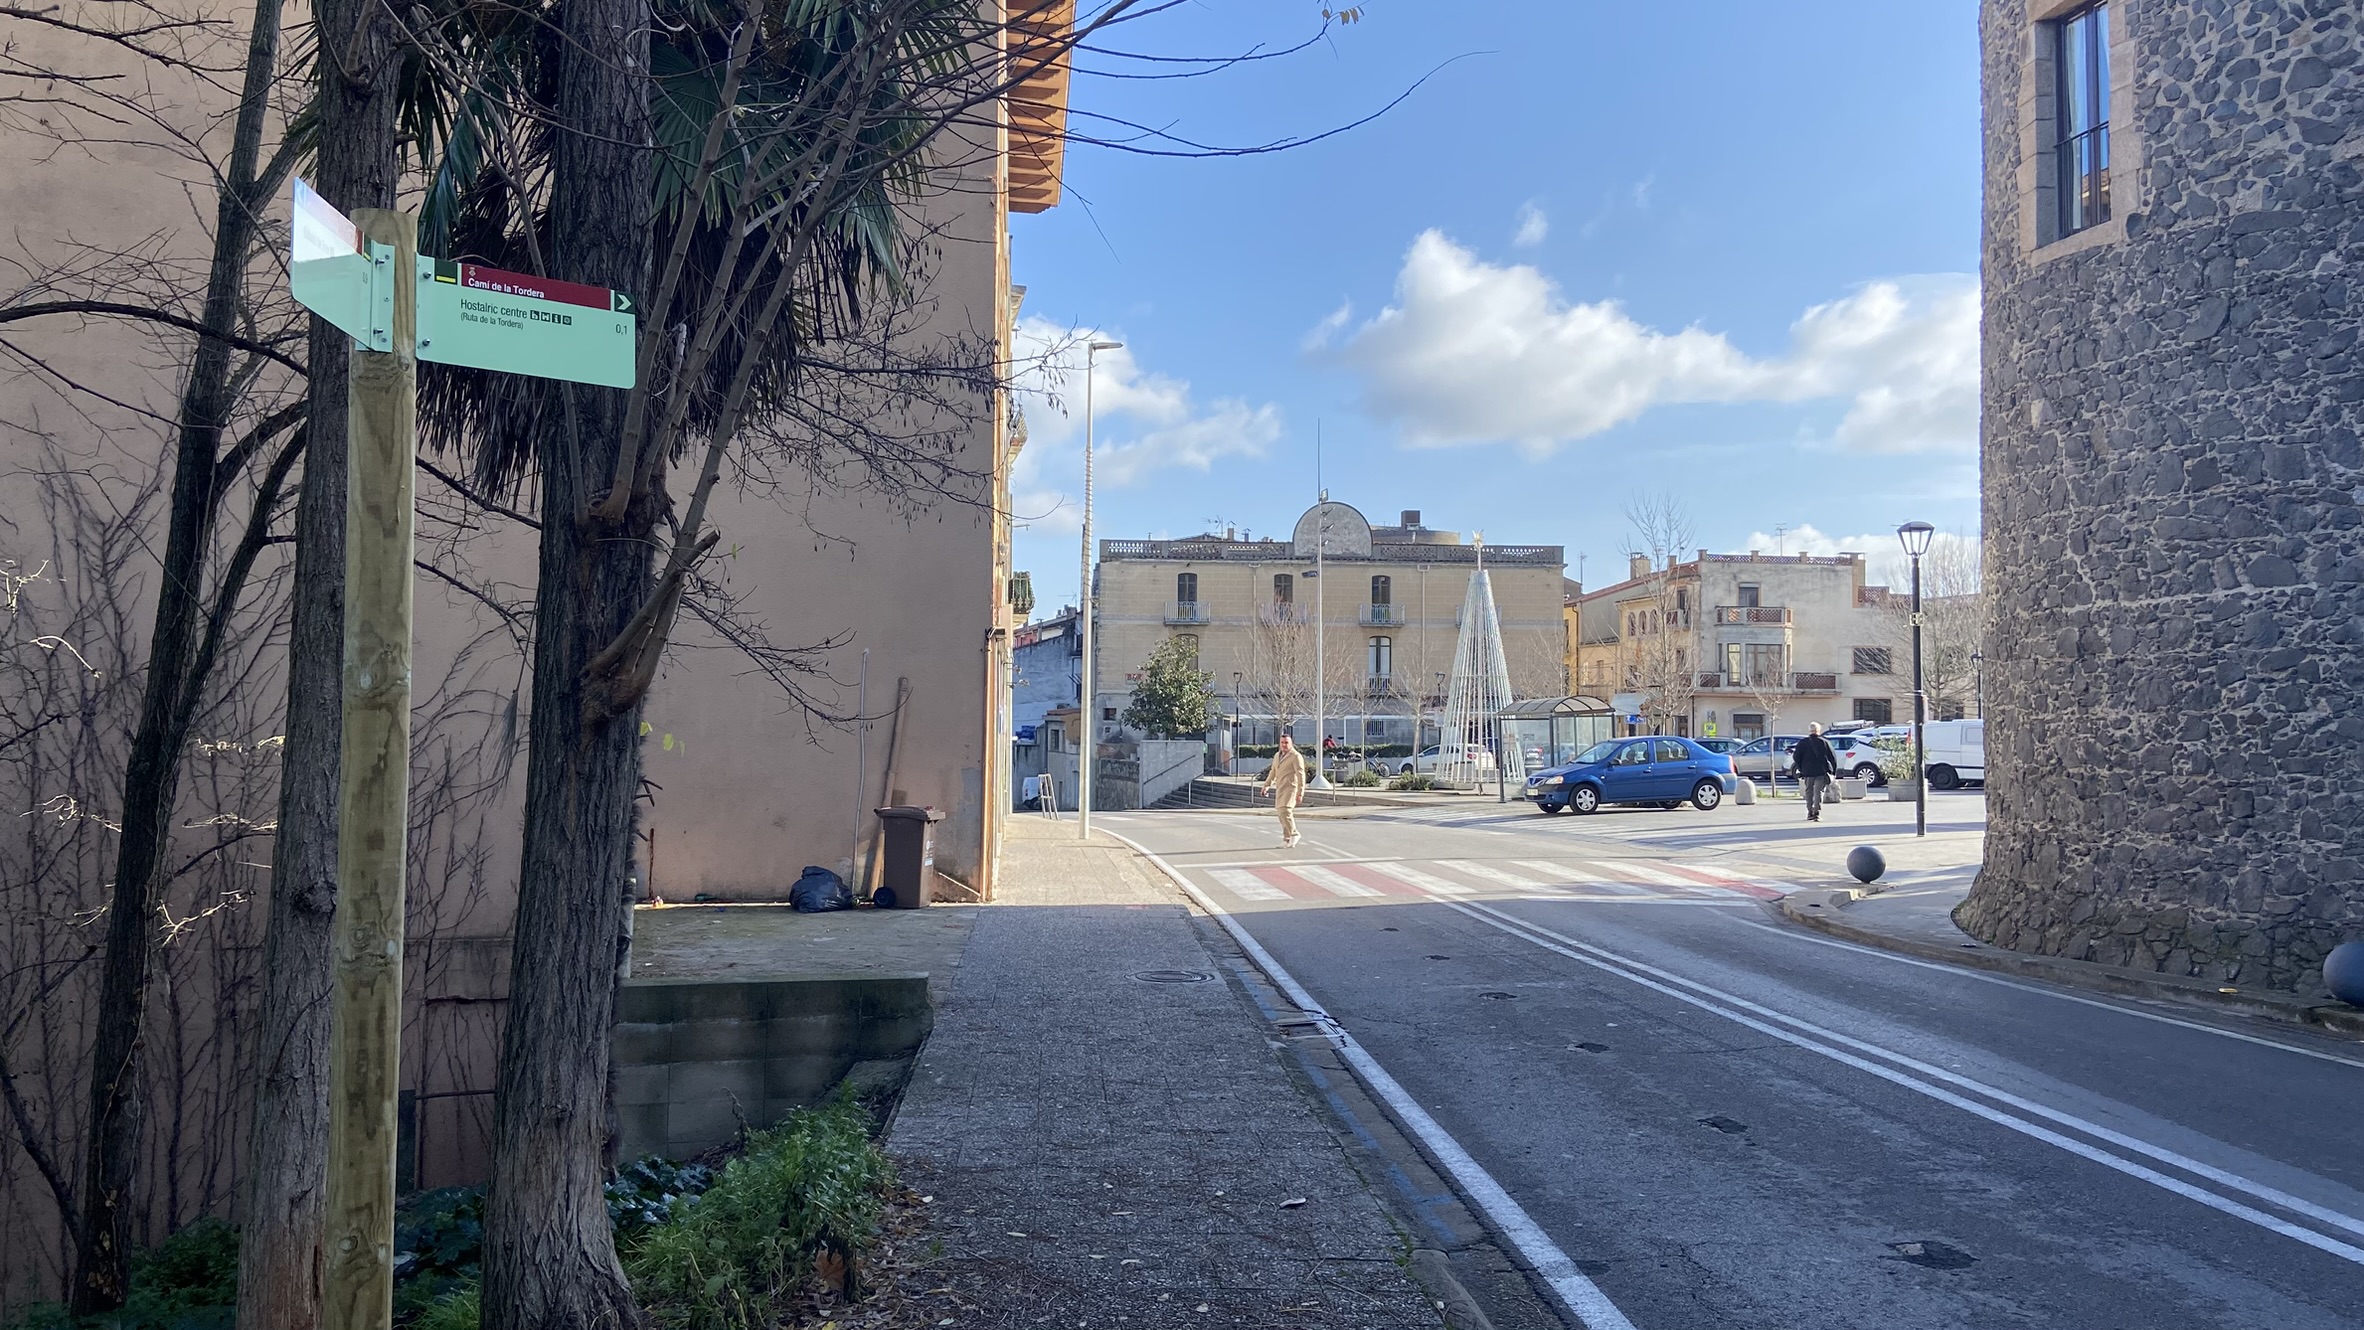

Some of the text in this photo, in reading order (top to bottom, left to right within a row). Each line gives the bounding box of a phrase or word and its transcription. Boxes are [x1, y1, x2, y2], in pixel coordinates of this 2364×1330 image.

[468, 278, 545, 299] Camí de la Tordera
[460, 299, 528, 319] Hostalric centre
[460, 312, 524, 331] (Ruta de la Tordera)
[615, 324, 628, 336] 0,1
